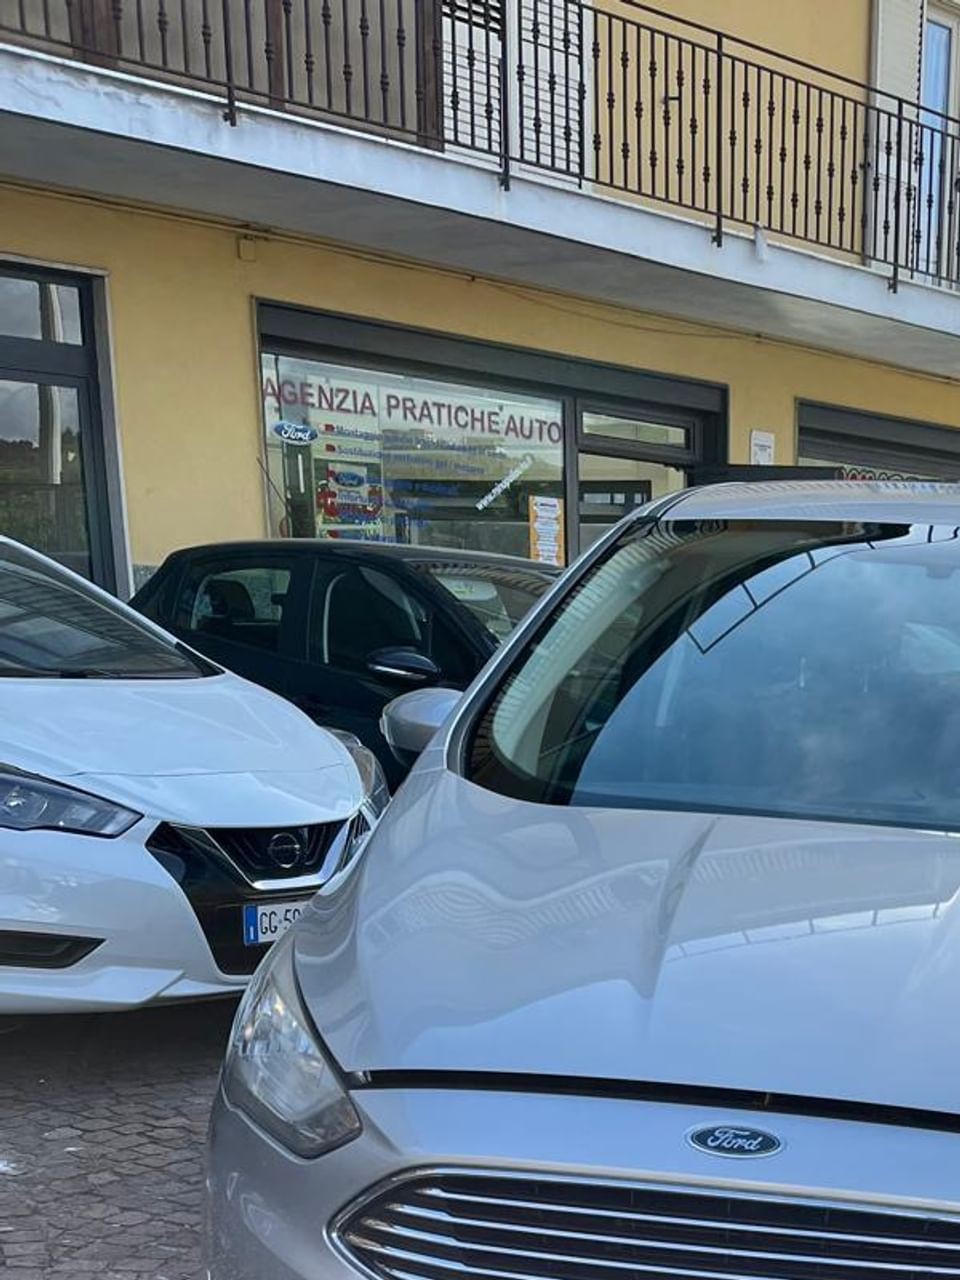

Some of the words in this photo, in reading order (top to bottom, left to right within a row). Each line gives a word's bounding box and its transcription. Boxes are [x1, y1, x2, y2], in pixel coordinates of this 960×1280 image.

[263, 377, 376, 417] AGENZIA
[386, 394, 500, 435] PRATICHE
[504, 414, 562, 444] AUTO
[707, 1128, 763, 1150] Ford
